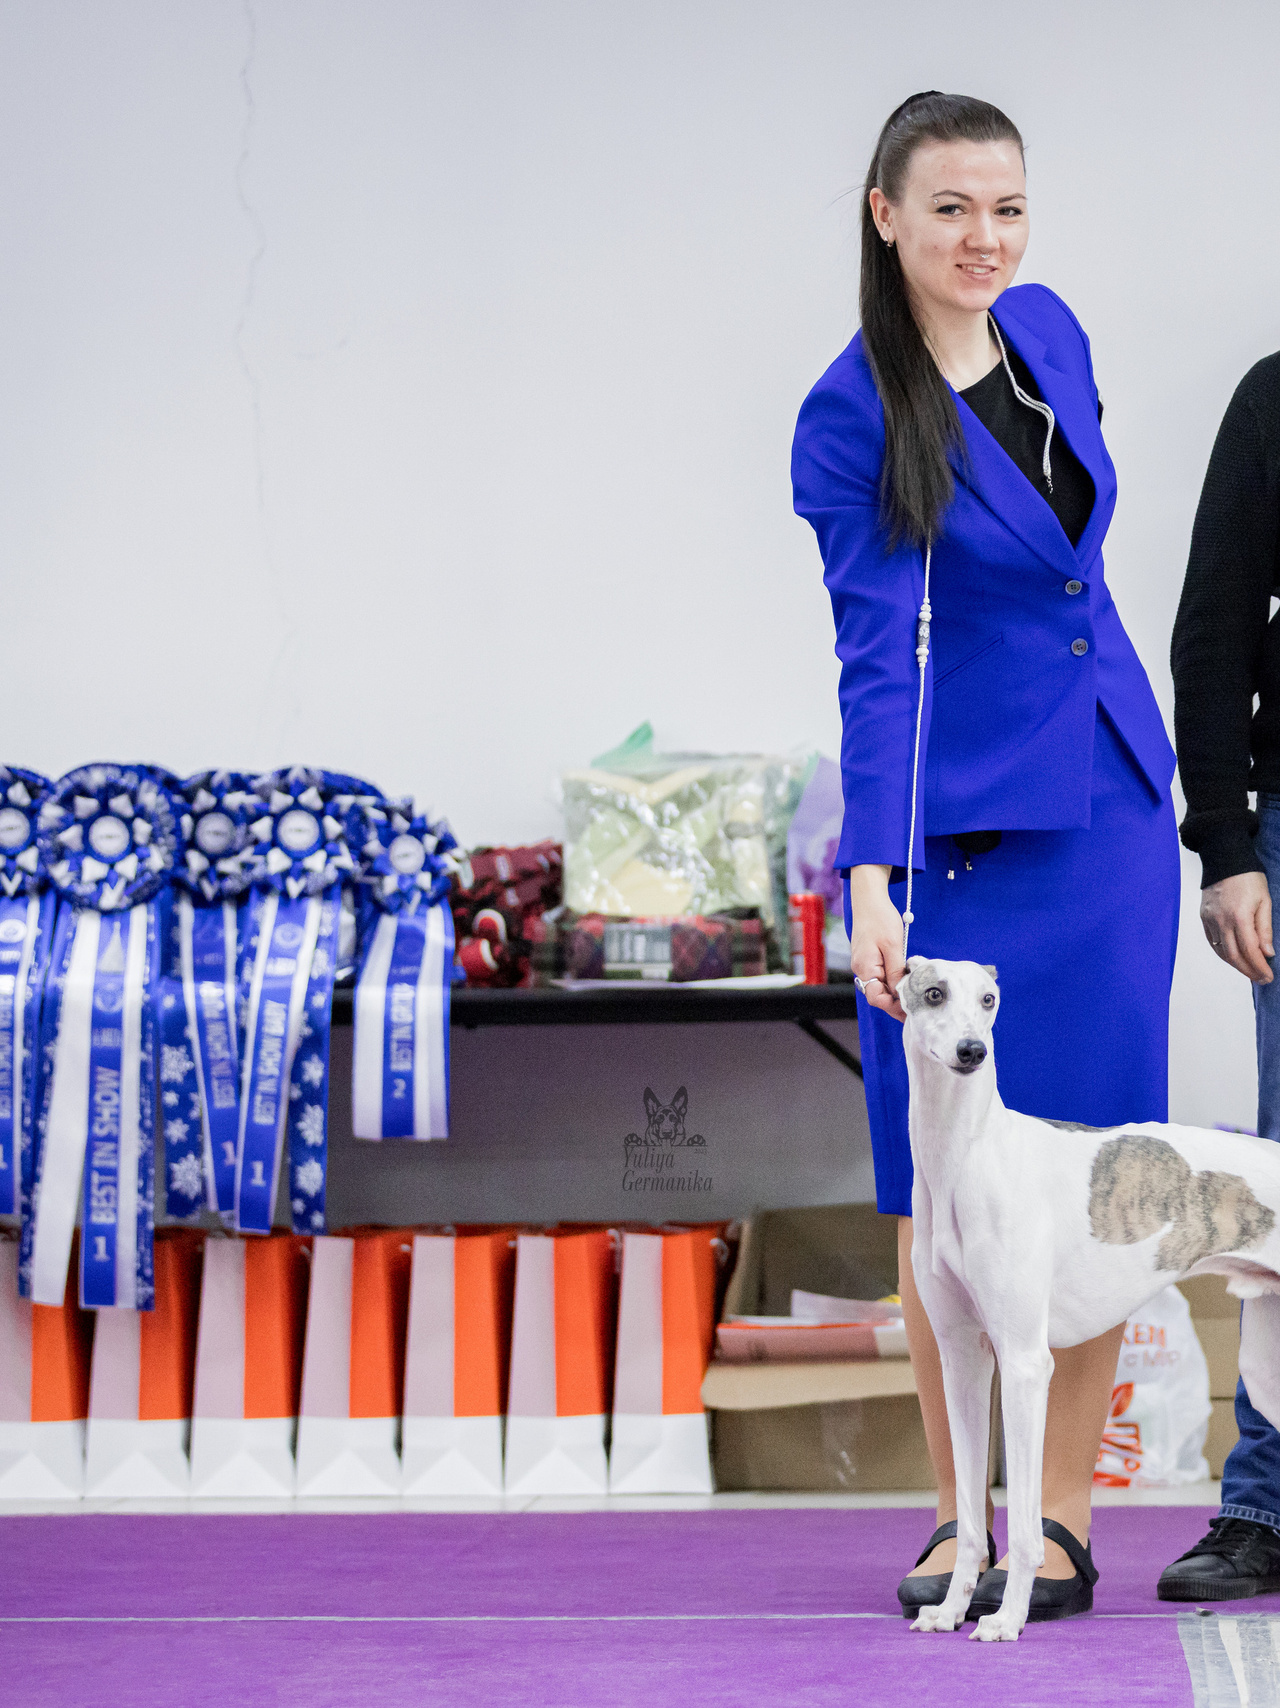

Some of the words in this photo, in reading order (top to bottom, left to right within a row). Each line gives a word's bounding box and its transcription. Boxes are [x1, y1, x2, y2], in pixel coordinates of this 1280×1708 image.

[93, 1065, 120, 1138] SHOW
[92, 1141, 118, 1168] IN
[251, 1160, 266, 1187] 1
[91, 1170, 117, 1225] BEST
[94, 1235, 110, 1262] 1
